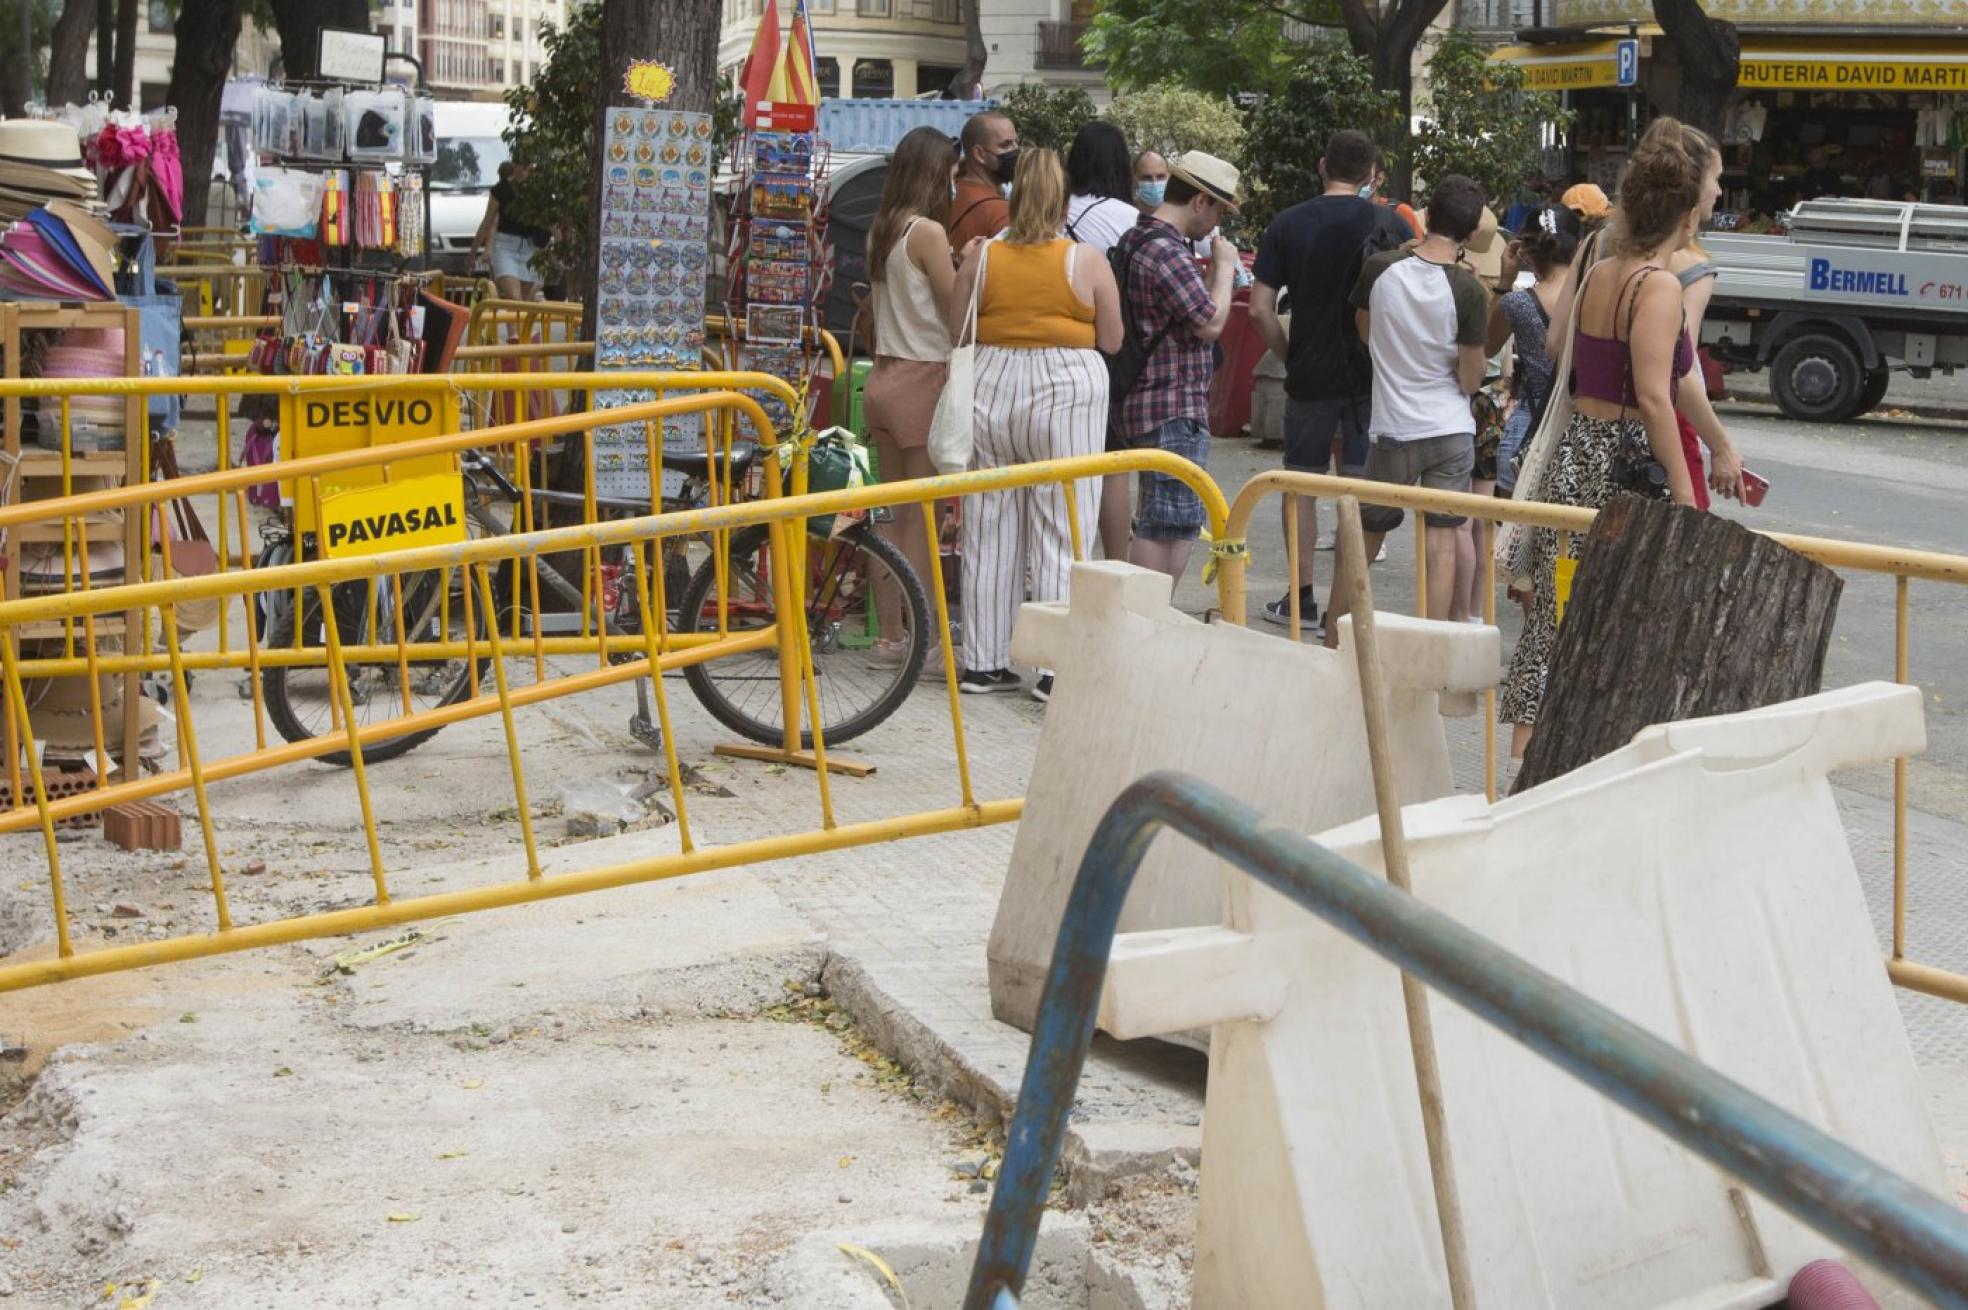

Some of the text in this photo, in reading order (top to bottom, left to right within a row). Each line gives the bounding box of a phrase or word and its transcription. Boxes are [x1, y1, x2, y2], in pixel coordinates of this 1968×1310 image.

[1621, 47, 1632, 80] P
[1836, 66, 1896, 84] DAVID
[1810, 258, 1909, 296] BERMELL
[1939, 284, 1962, 299] 671
[306, 399, 433, 428] DESVIO
[328, 502, 457, 548] PAVASAL
